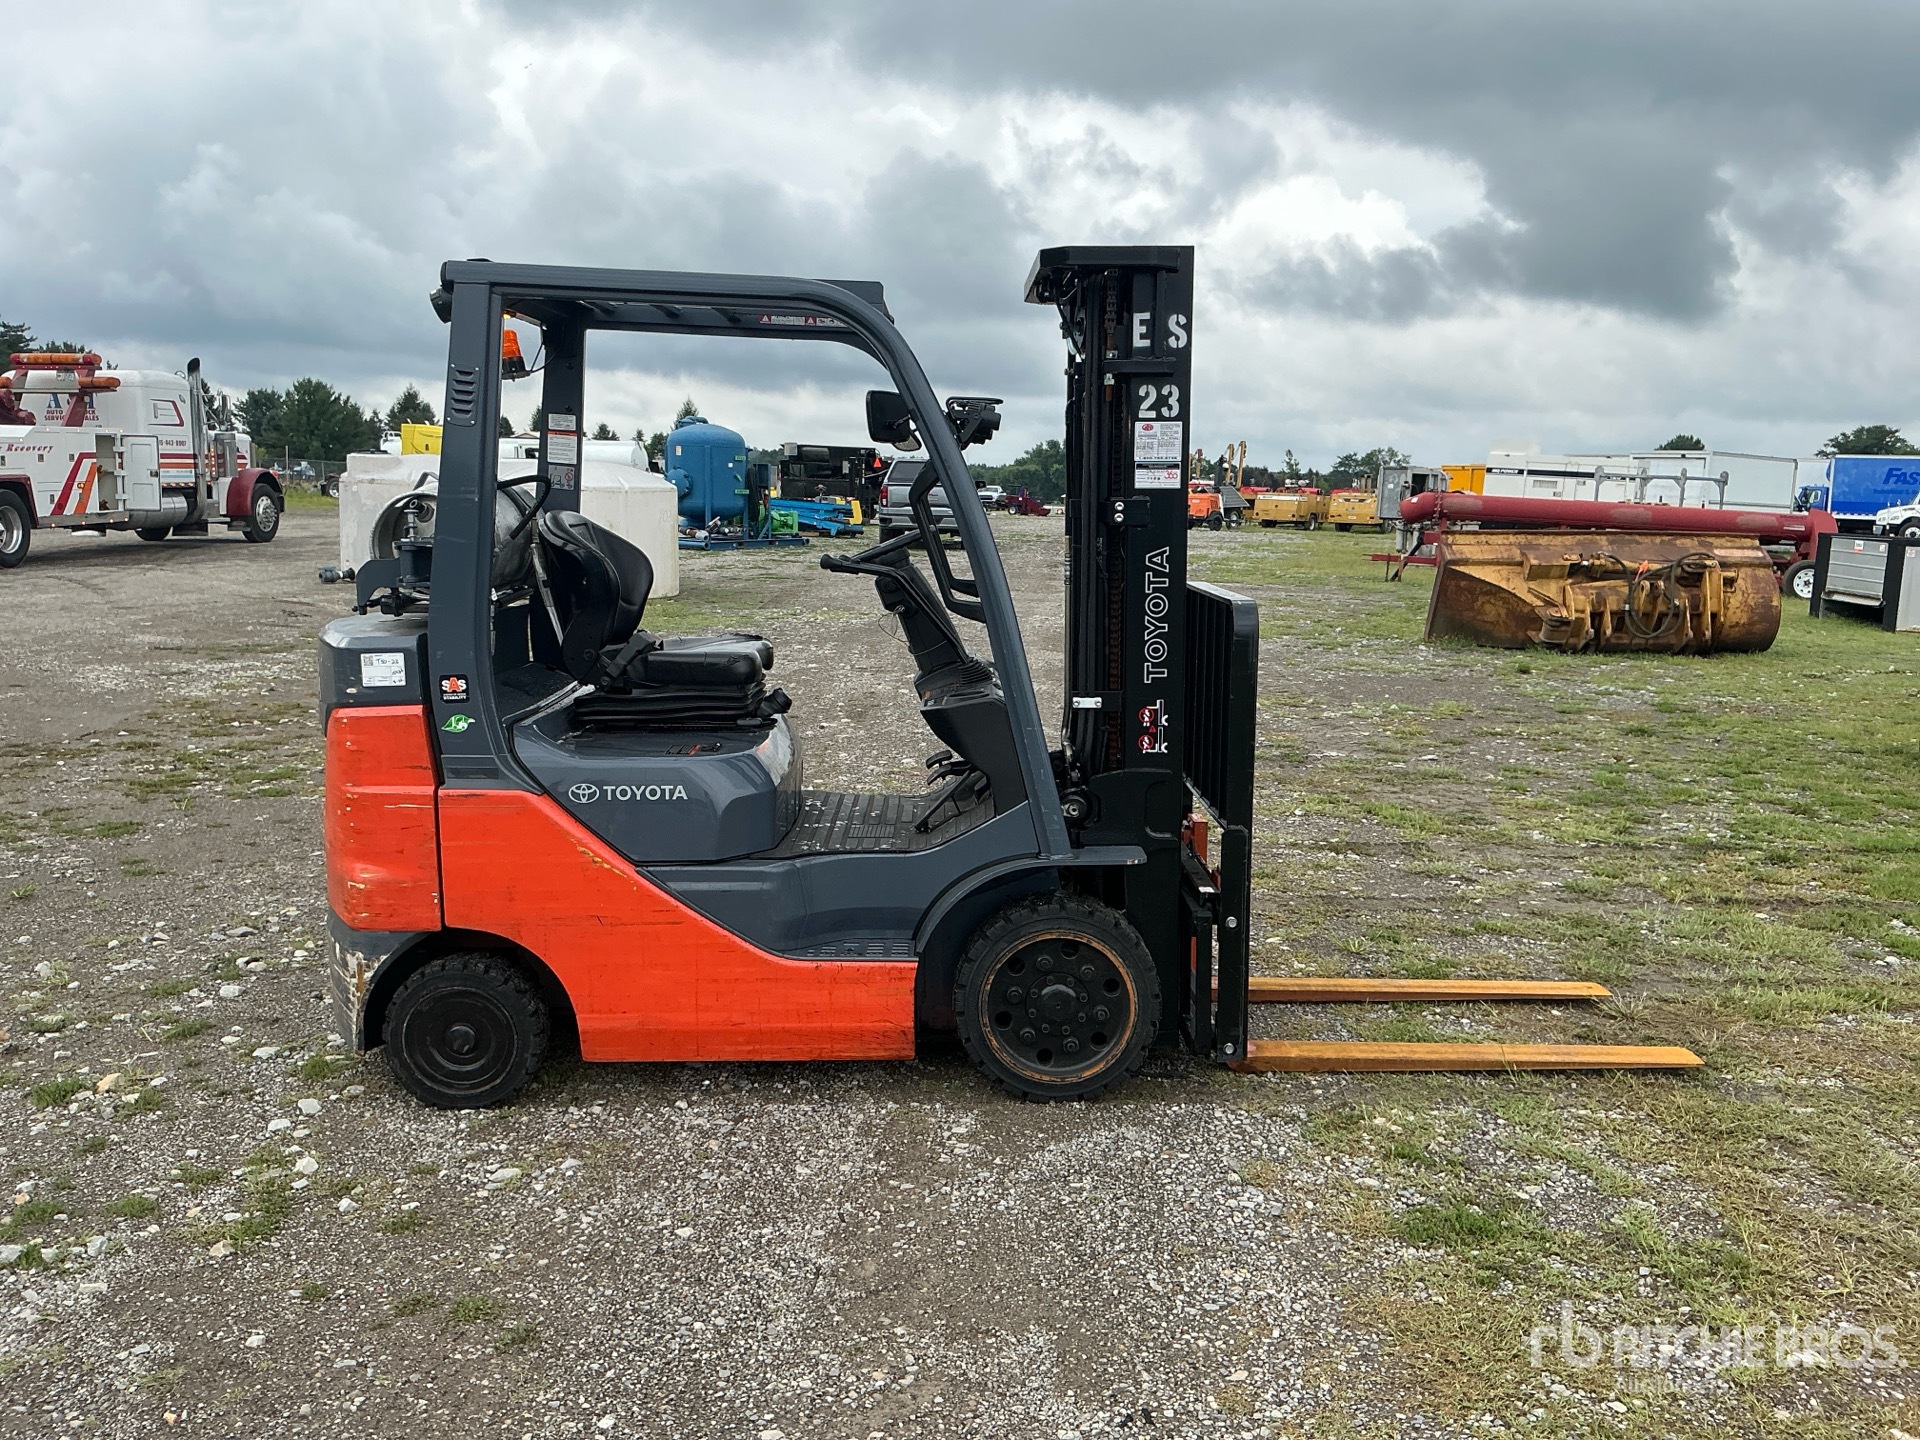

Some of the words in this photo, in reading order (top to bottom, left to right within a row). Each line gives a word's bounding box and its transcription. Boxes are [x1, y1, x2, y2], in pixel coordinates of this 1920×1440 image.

[1133, 312, 1150, 347] E
[1168, 314, 1187, 348] S
[1138, 384, 1180, 418] 23
[6, 443, 54, 454] Recovery
[1882, 467, 1920, 485] FAS
[1144, 546, 1170, 684] TOYOTA
[442, 677, 467, 692] SAS
[603, 785, 688, 800] TOYOTA
